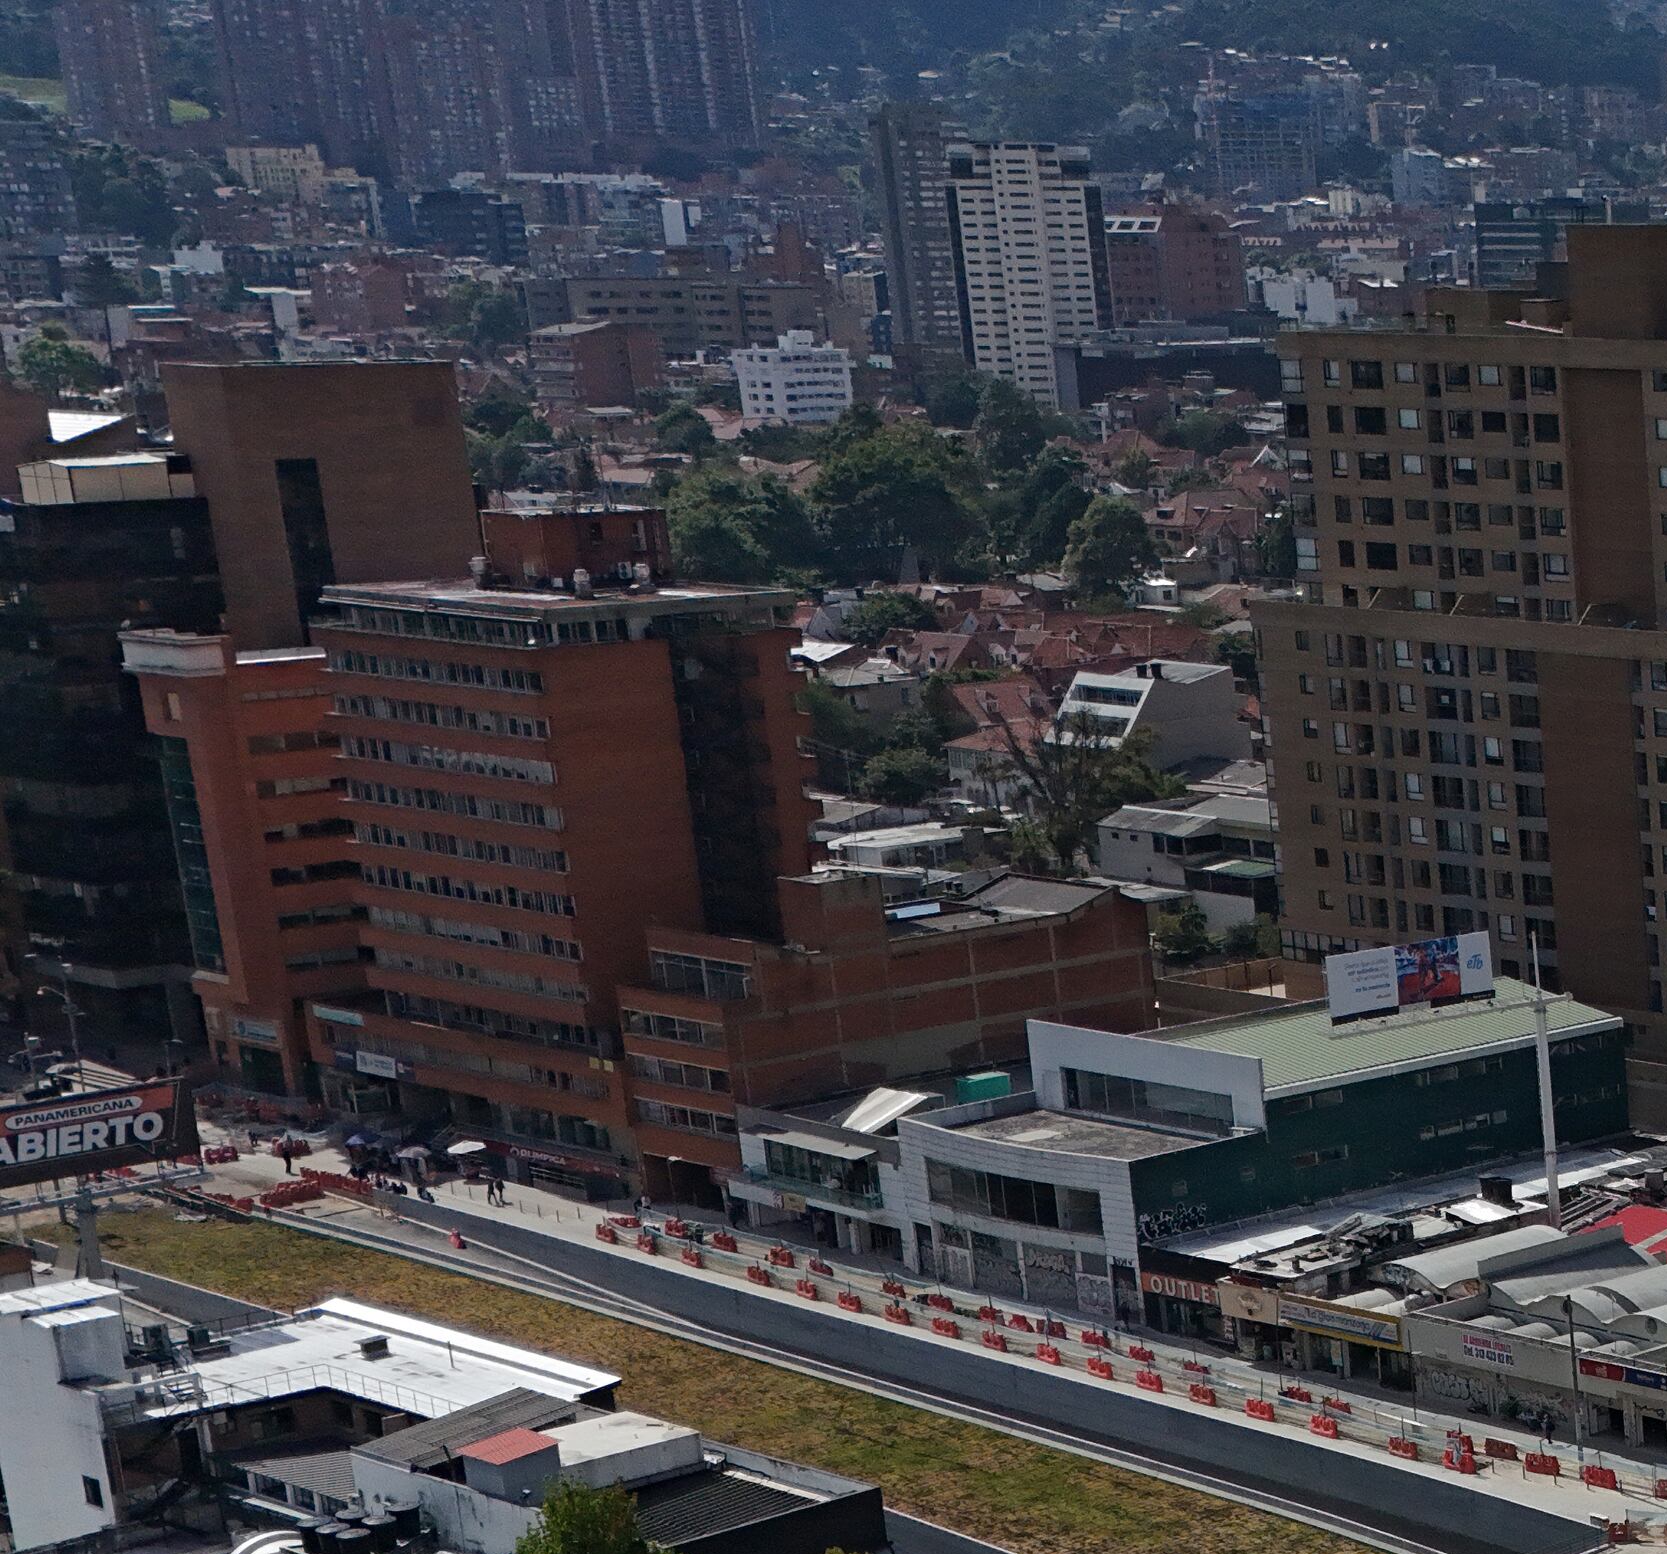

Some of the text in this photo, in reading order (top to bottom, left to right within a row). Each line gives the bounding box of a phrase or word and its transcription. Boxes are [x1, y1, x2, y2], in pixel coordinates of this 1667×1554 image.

[15, 1098, 134, 1127] PANAMERICANA
[0, 1111, 164, 1166] ABIERTO
[1150, 1277, 1220, 1305] OUTLET
